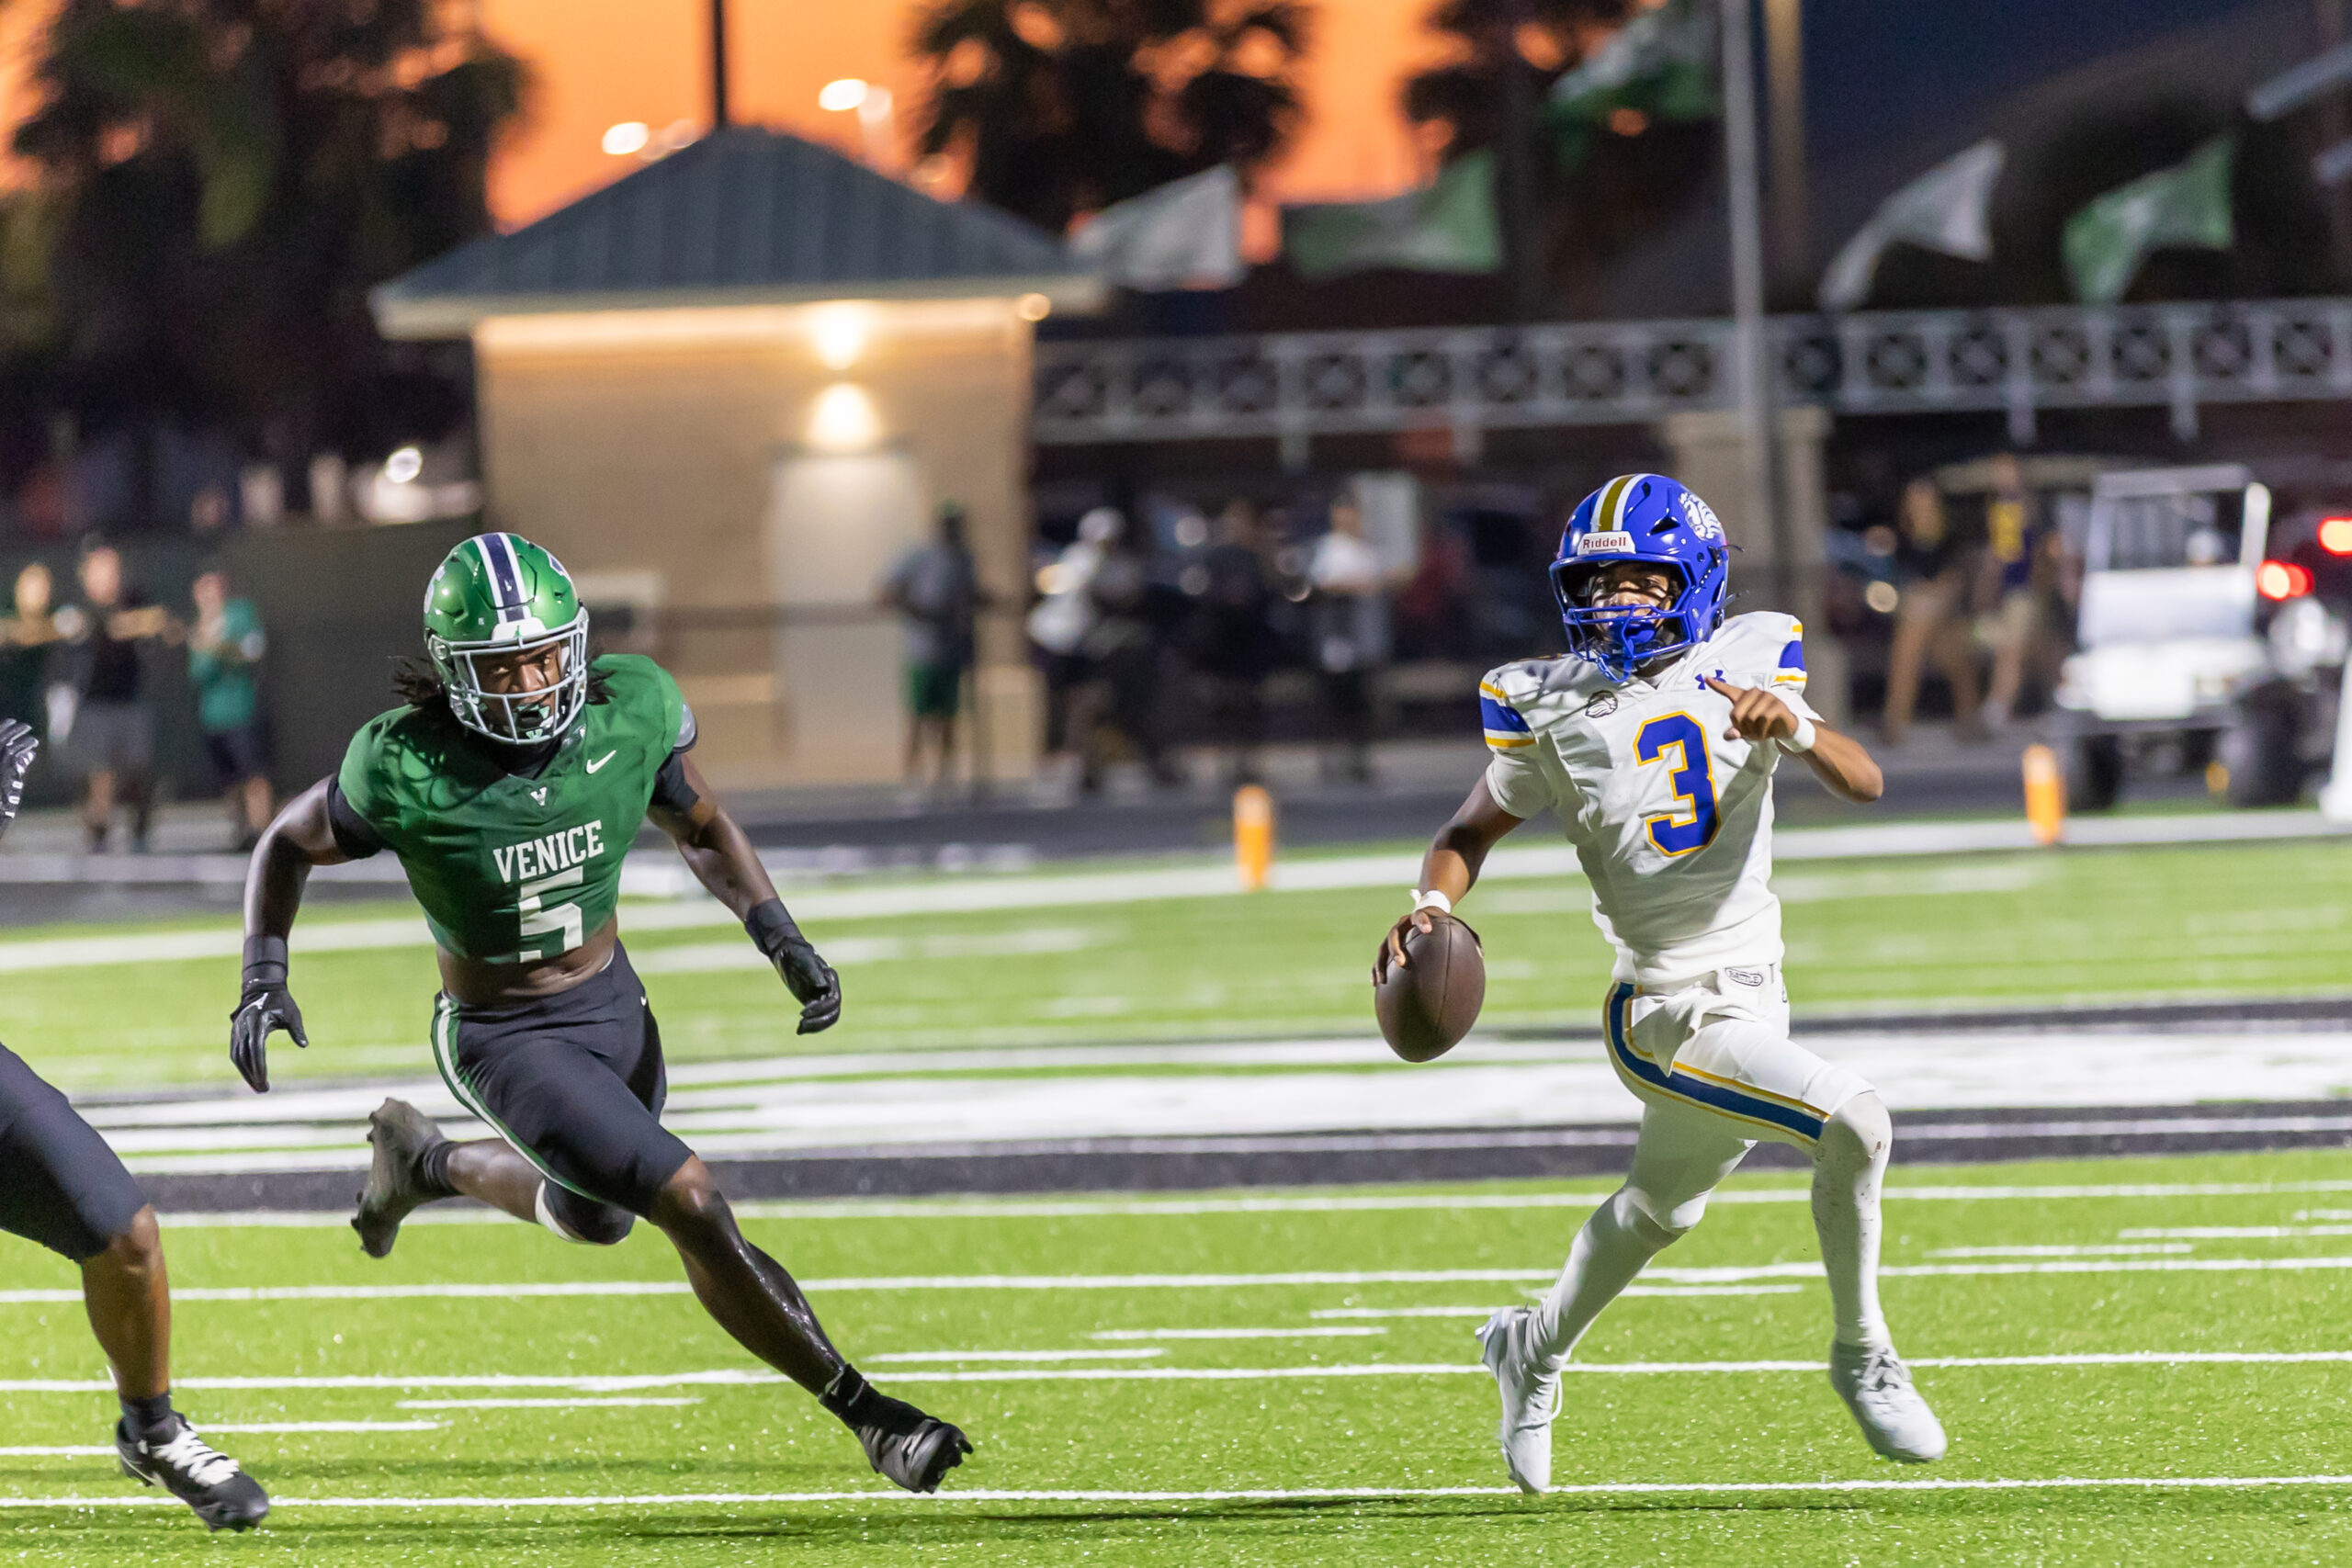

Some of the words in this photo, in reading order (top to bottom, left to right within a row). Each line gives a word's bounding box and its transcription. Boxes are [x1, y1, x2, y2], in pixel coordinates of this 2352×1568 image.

[1582, 537, 1626, 549] Riddell
[1634, 710, 1721, 857] 3
[493, 819, 604, 884] VENICE
[519, 866, 583, 963] 5
